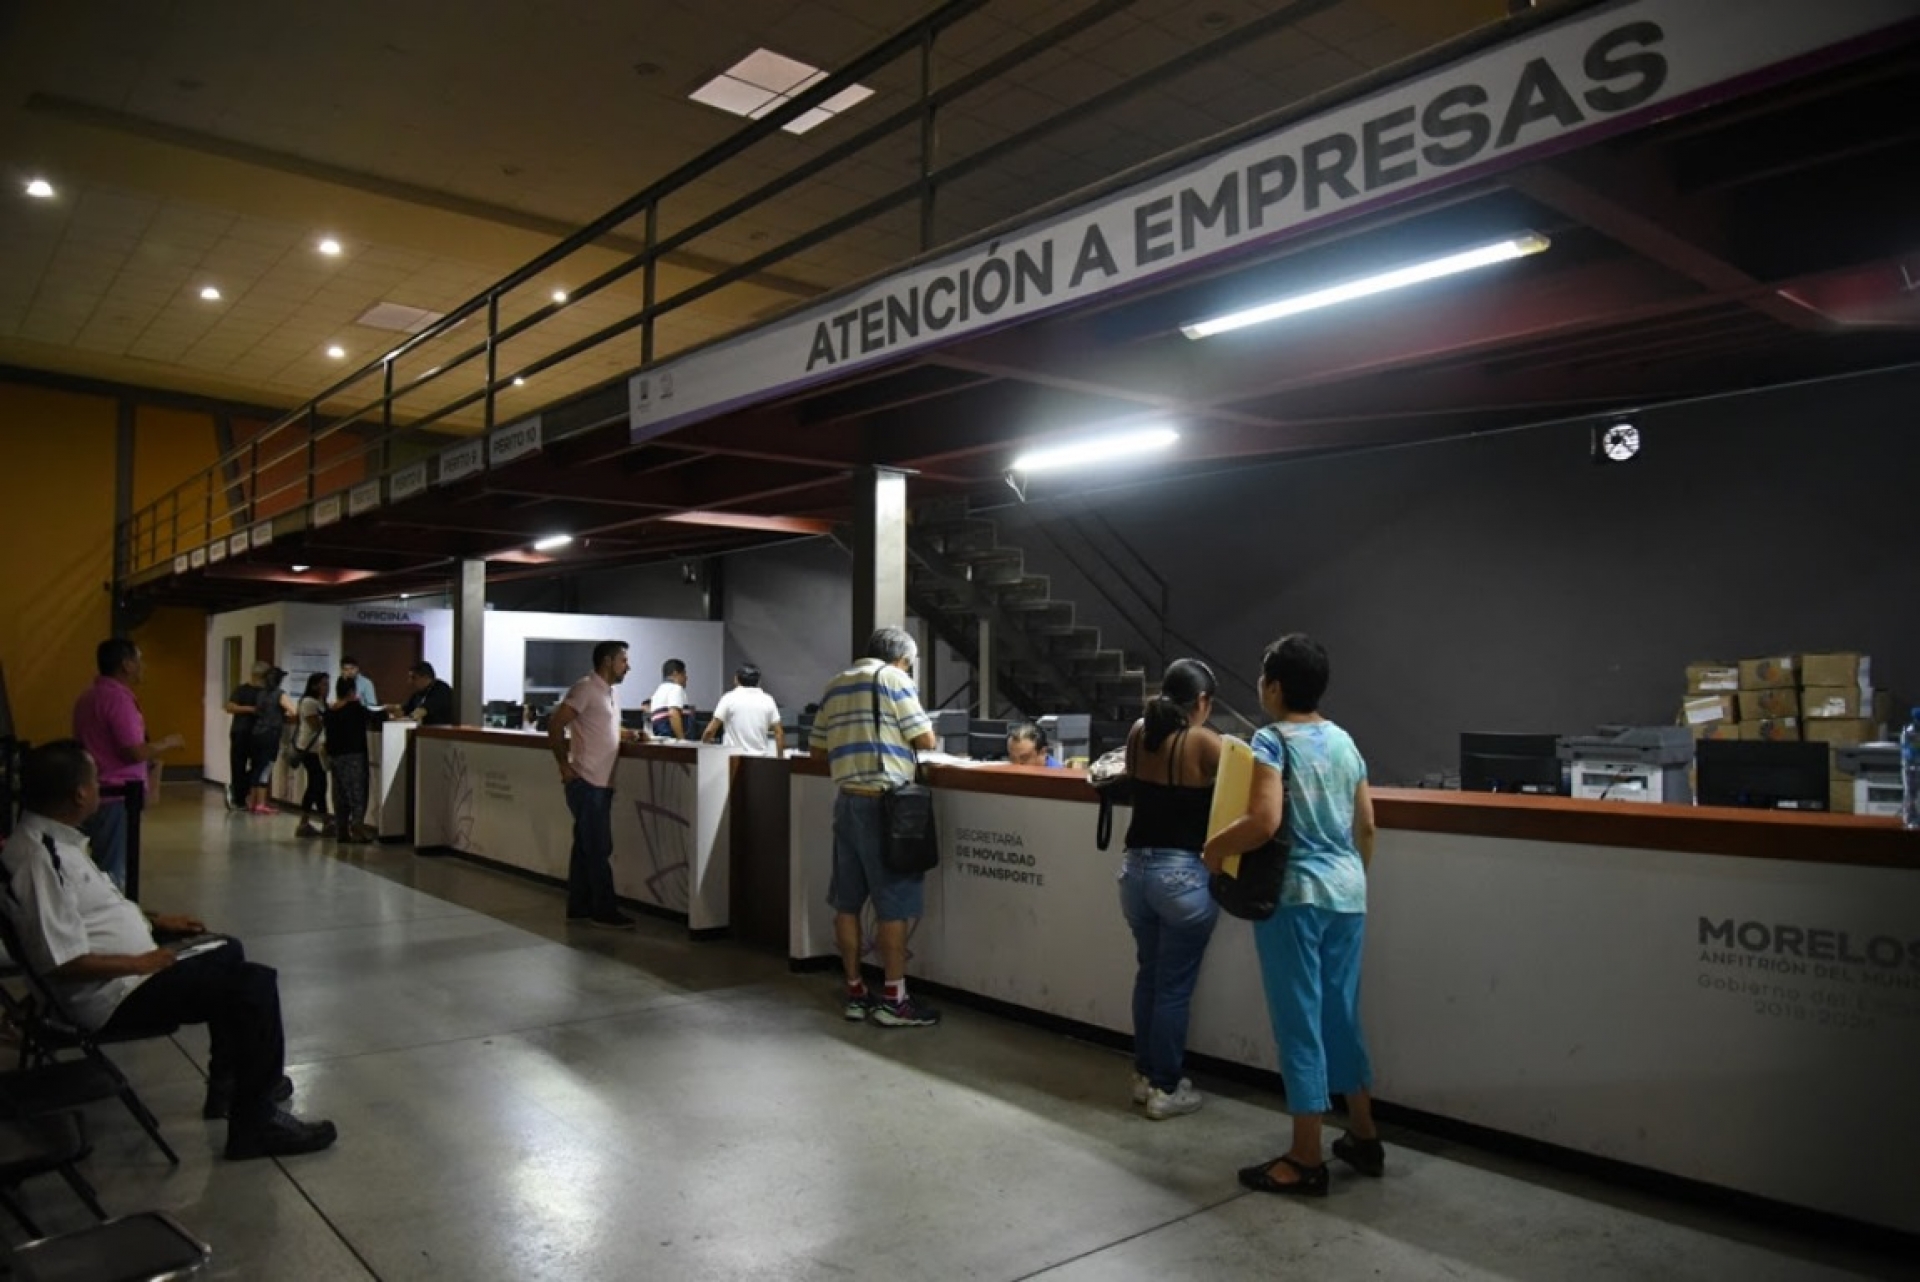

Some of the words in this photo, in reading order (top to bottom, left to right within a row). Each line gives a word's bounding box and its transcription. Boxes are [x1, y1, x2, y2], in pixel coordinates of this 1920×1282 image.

[805, 239, 1053, 371] ATENCIÓN
[1069, 224, 1118, 288] A
[1135, 20, 1668, 267] EMPRESAS
[358, 610, 410, 621] OFICINA
[956, 827, 1023, 847] SECRETARÍA
[956, 845, 970, 857] DE
[972, 847, 1036, 867] MOVILIDAD
[957, 862, 963, 874] Y
[967, 863, 1044, 886] TRANSPORTE
[1699, 950, 1806, 976] ANFITRIÓN
[1814, 963, 1855, 983] DEL
[1698, 973, 1800, 1003] Gobierno
